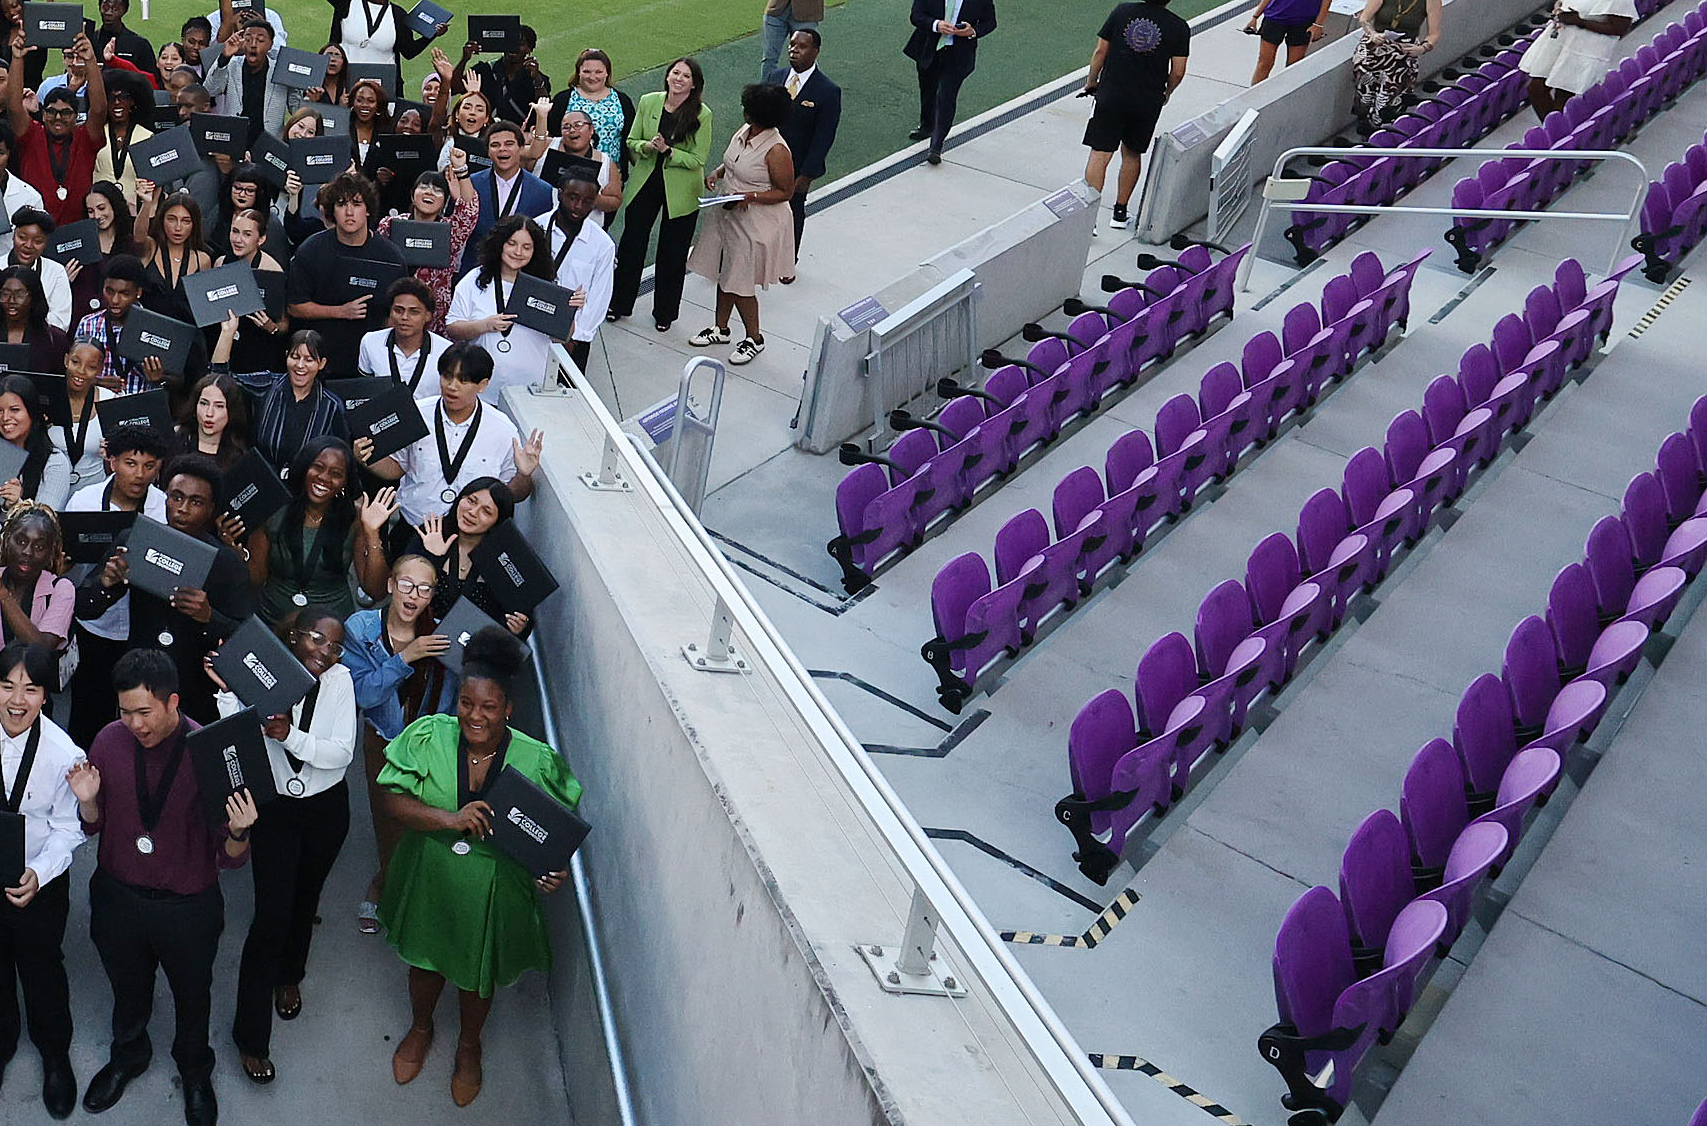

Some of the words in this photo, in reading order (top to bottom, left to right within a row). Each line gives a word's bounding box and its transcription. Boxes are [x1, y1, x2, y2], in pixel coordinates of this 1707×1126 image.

[158, 557, 182, 571] COLLEGE
[927, 650, 934, 660] B
[254, 664, 275, 687] COLLEGE
[230, 760, 241, 787] COLLEGE
[1063, 810, 1071, 820] C
[521, 819, 547, 841] COLLEGE
[1269, 1045, 1280, 1059] D
